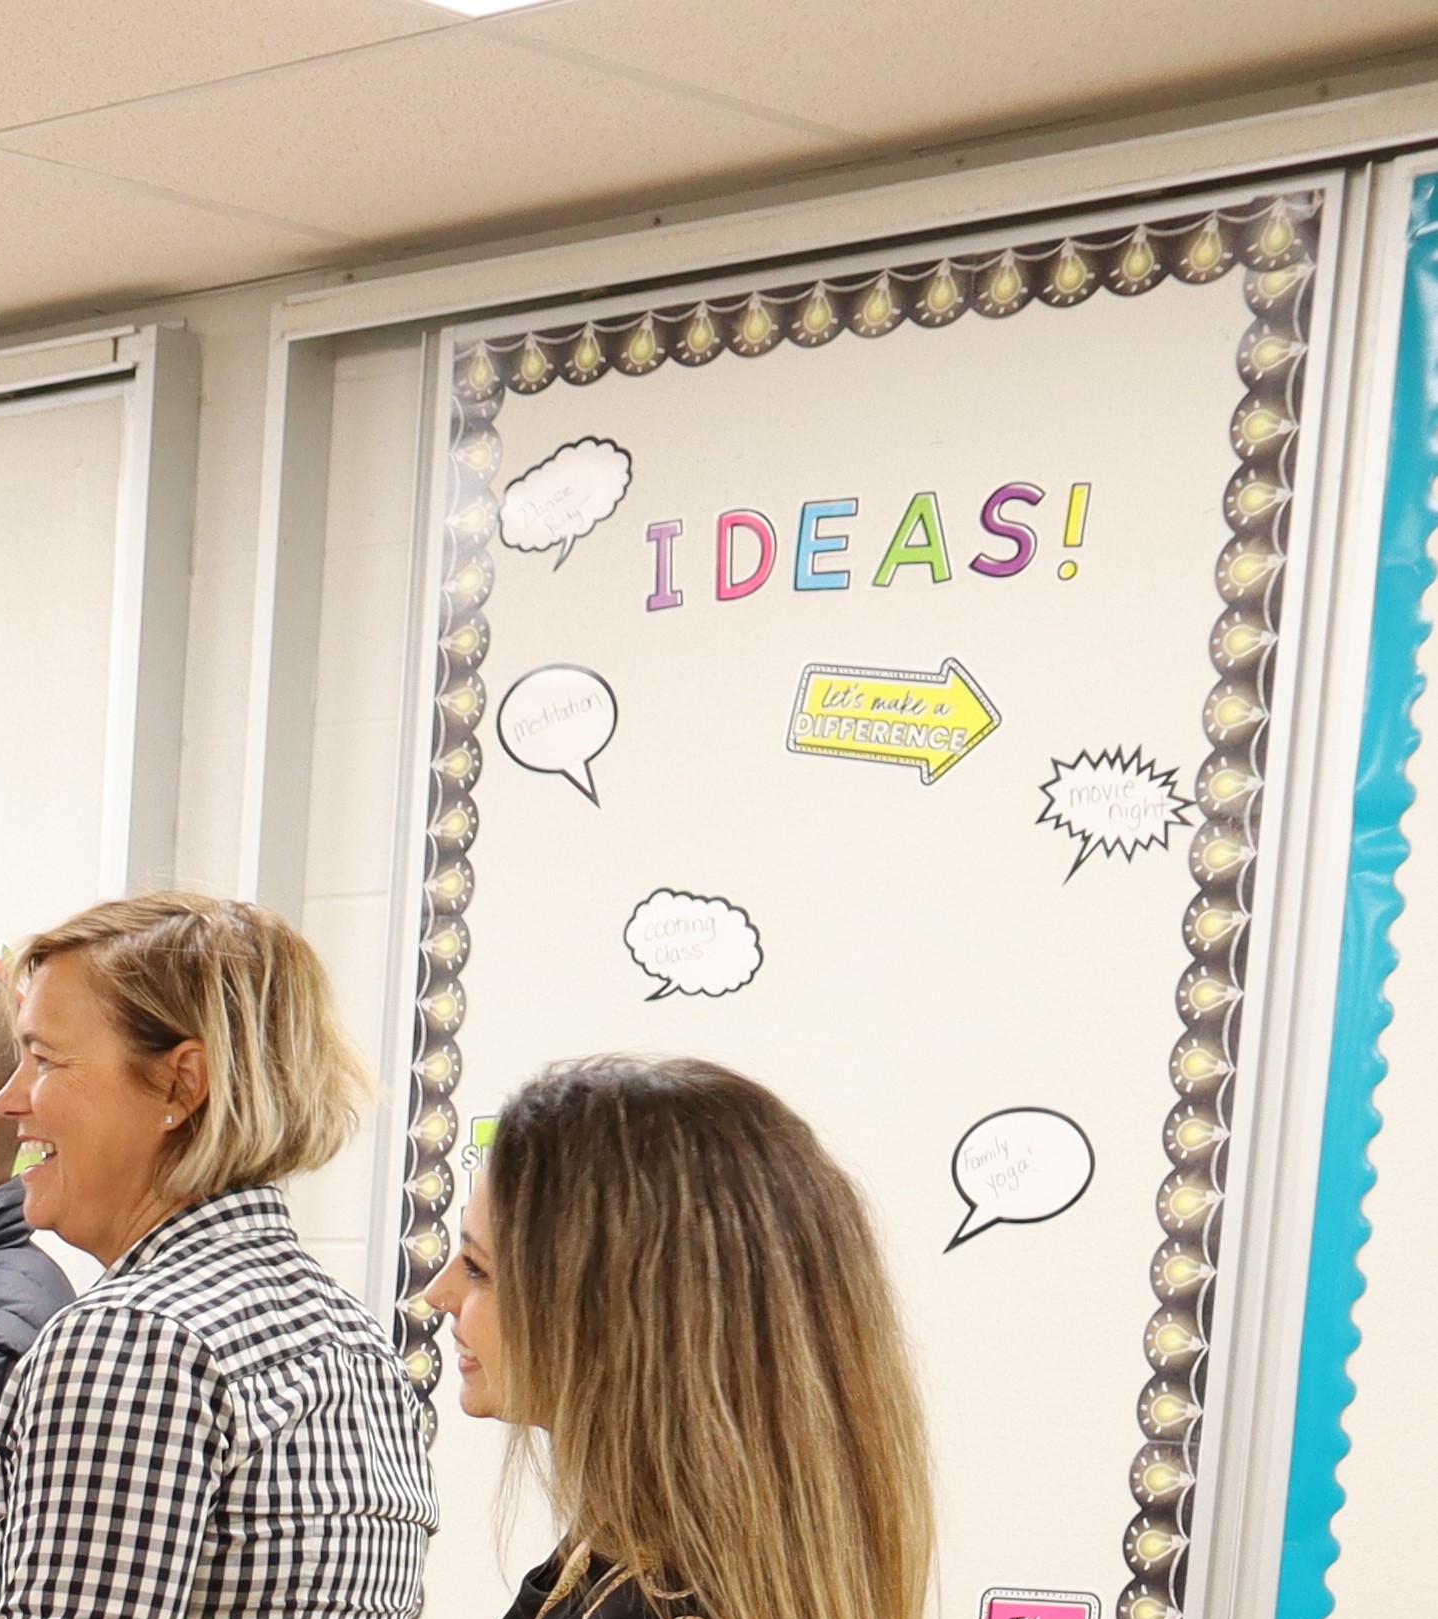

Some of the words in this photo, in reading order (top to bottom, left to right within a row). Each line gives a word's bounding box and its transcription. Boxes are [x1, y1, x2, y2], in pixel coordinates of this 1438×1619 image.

[645, 481, 1092, 612] IDEAS!
[821, 682, 865, 710] Let's
[871, 690, 926, 716] make
[933, 702, 952, 717] a
[793, 712, 968, 753] DIFFERENCE
[1070, 780, 1135, 807] movie
[1108, 793, 1173, 831] night
[963, 1136, 1010, 1172] Family
